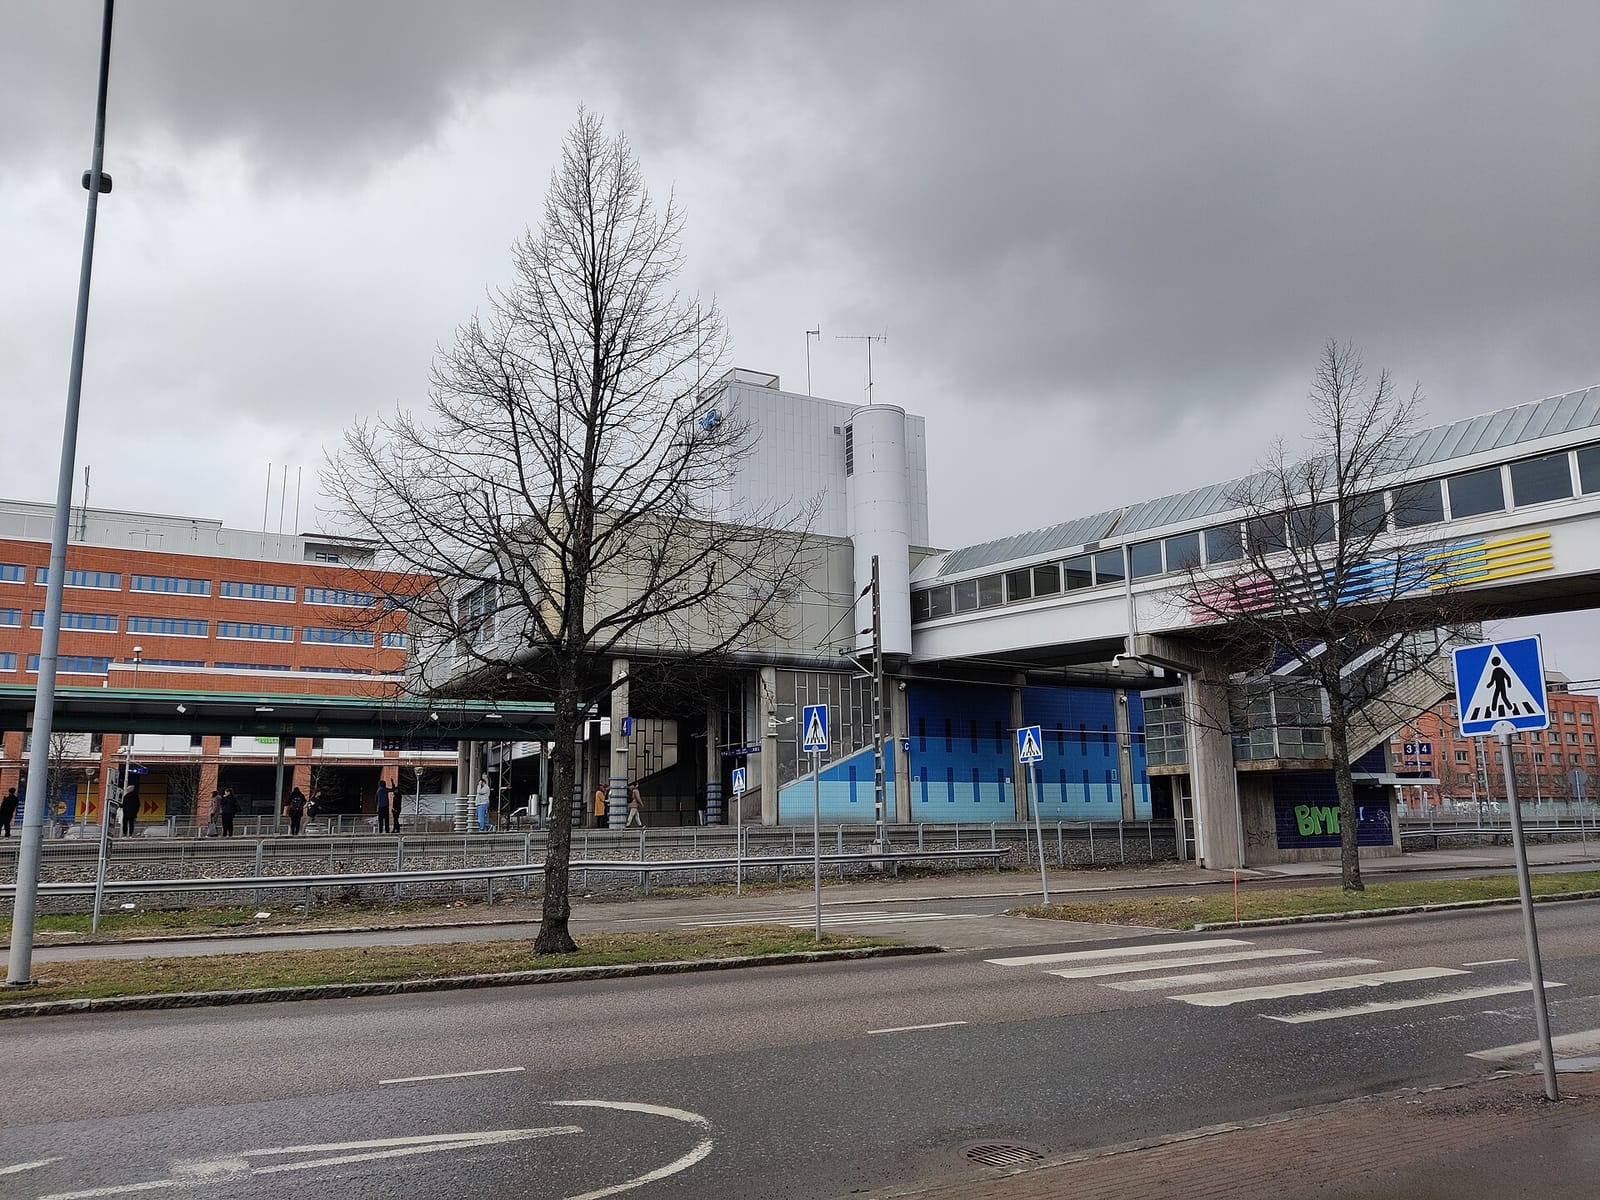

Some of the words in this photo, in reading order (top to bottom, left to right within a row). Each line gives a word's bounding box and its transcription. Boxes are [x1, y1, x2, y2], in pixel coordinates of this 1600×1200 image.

[904, 742, 910, 751] C
[1406, 744, 1413, 754] 3
[1421, 744, 1427, 753] 4
